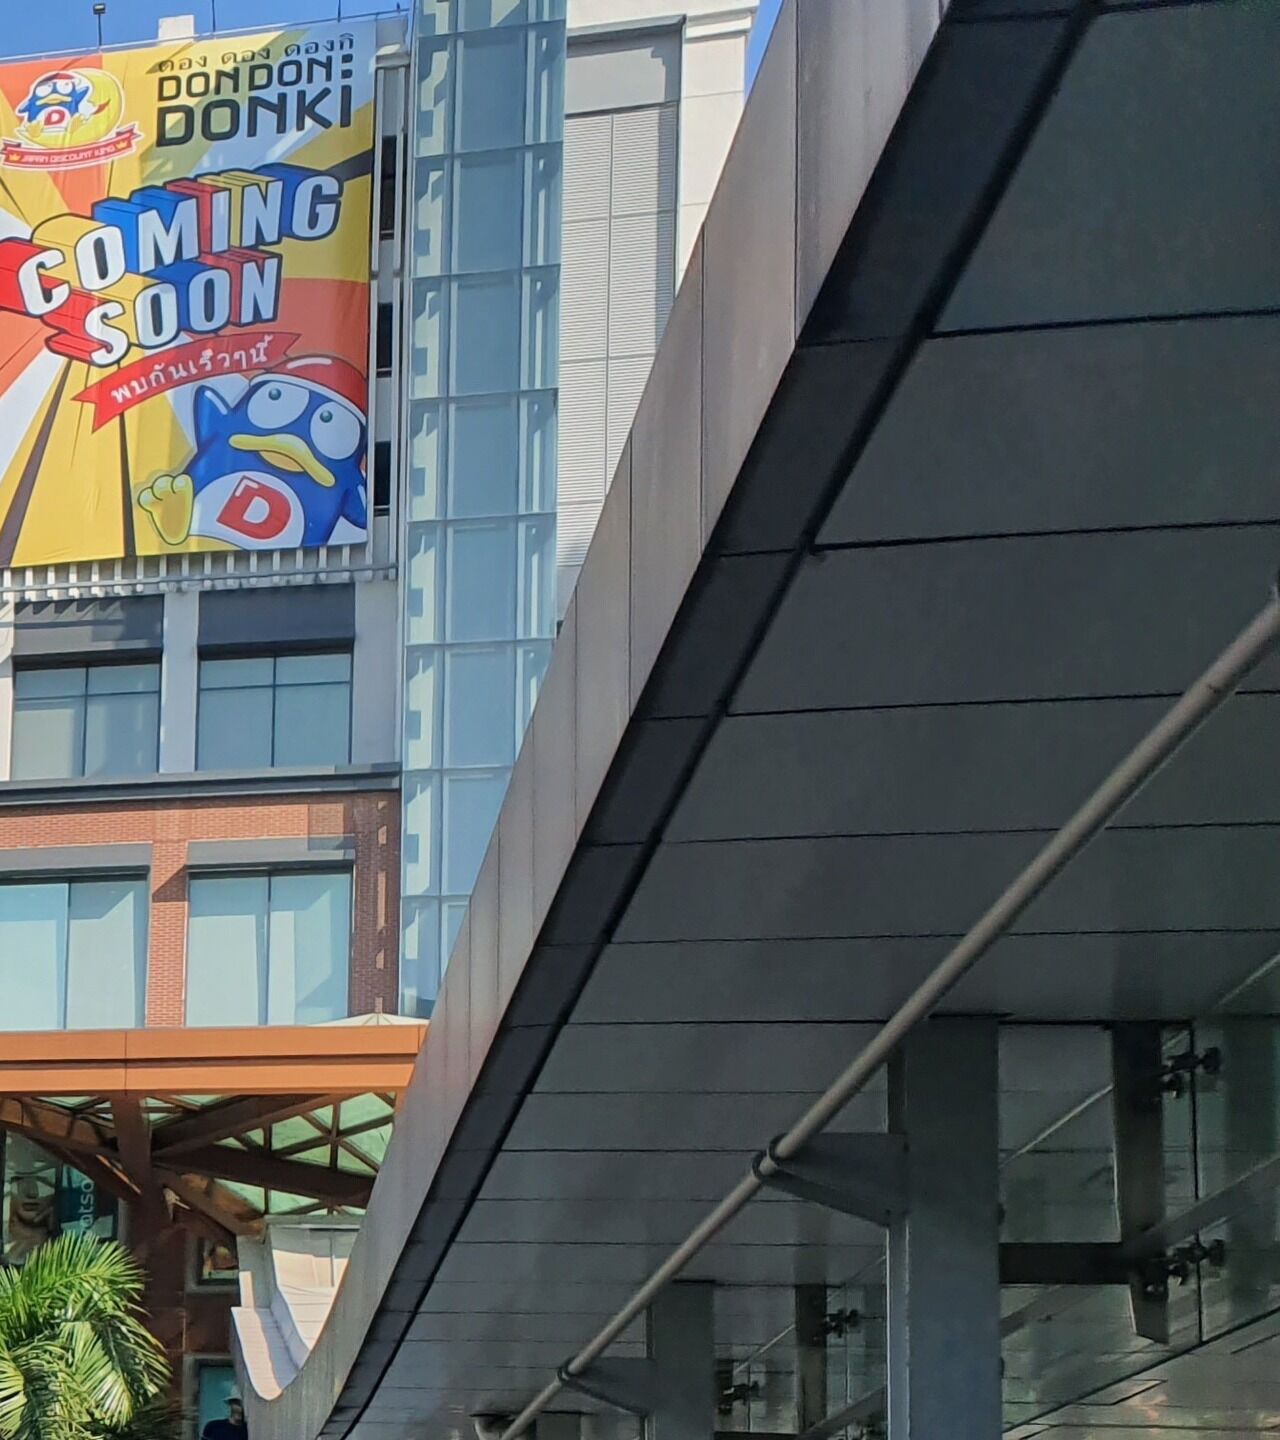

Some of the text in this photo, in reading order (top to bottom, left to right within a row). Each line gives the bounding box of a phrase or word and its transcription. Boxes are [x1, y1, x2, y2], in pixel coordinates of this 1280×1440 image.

[158, 54, 207, 72] ดอง
[222, 47, 270, 64] ดอง
[156, 85, 352, 147] DONKI
[20, 143, 116, 164] JAPAN DISCOUNT KING
[12, 172, 341, 317] COMING
[83, 254, 281, 367] SOON
